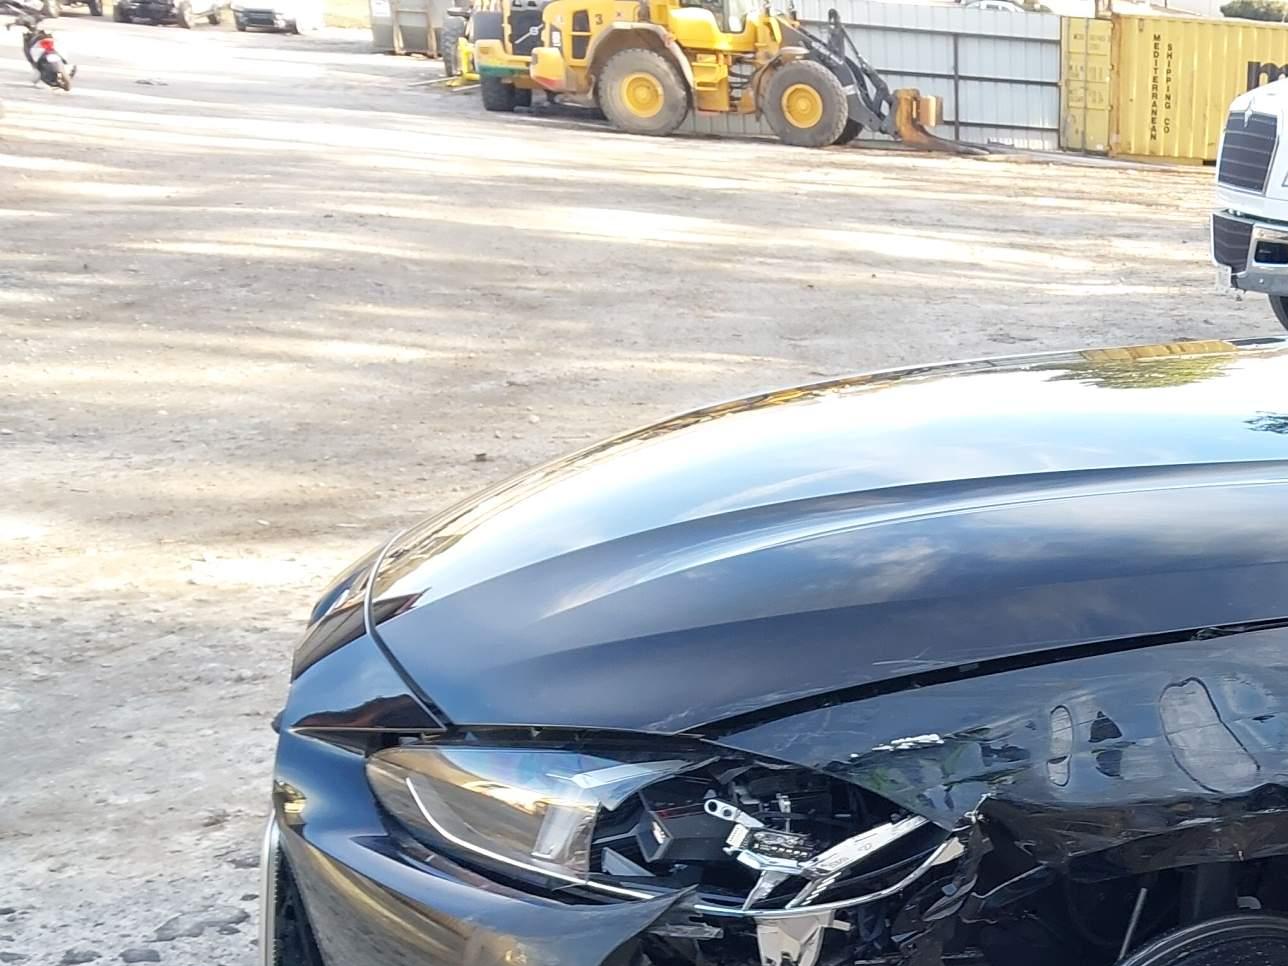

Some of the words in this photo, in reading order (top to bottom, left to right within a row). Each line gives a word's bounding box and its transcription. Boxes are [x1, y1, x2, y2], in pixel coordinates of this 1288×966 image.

[1150, 34, 1161, 141] MEDITERRANEAN
[1164, 43, 1173, 110] SHIPPING
[1163, 118, 1171, 134] CO
